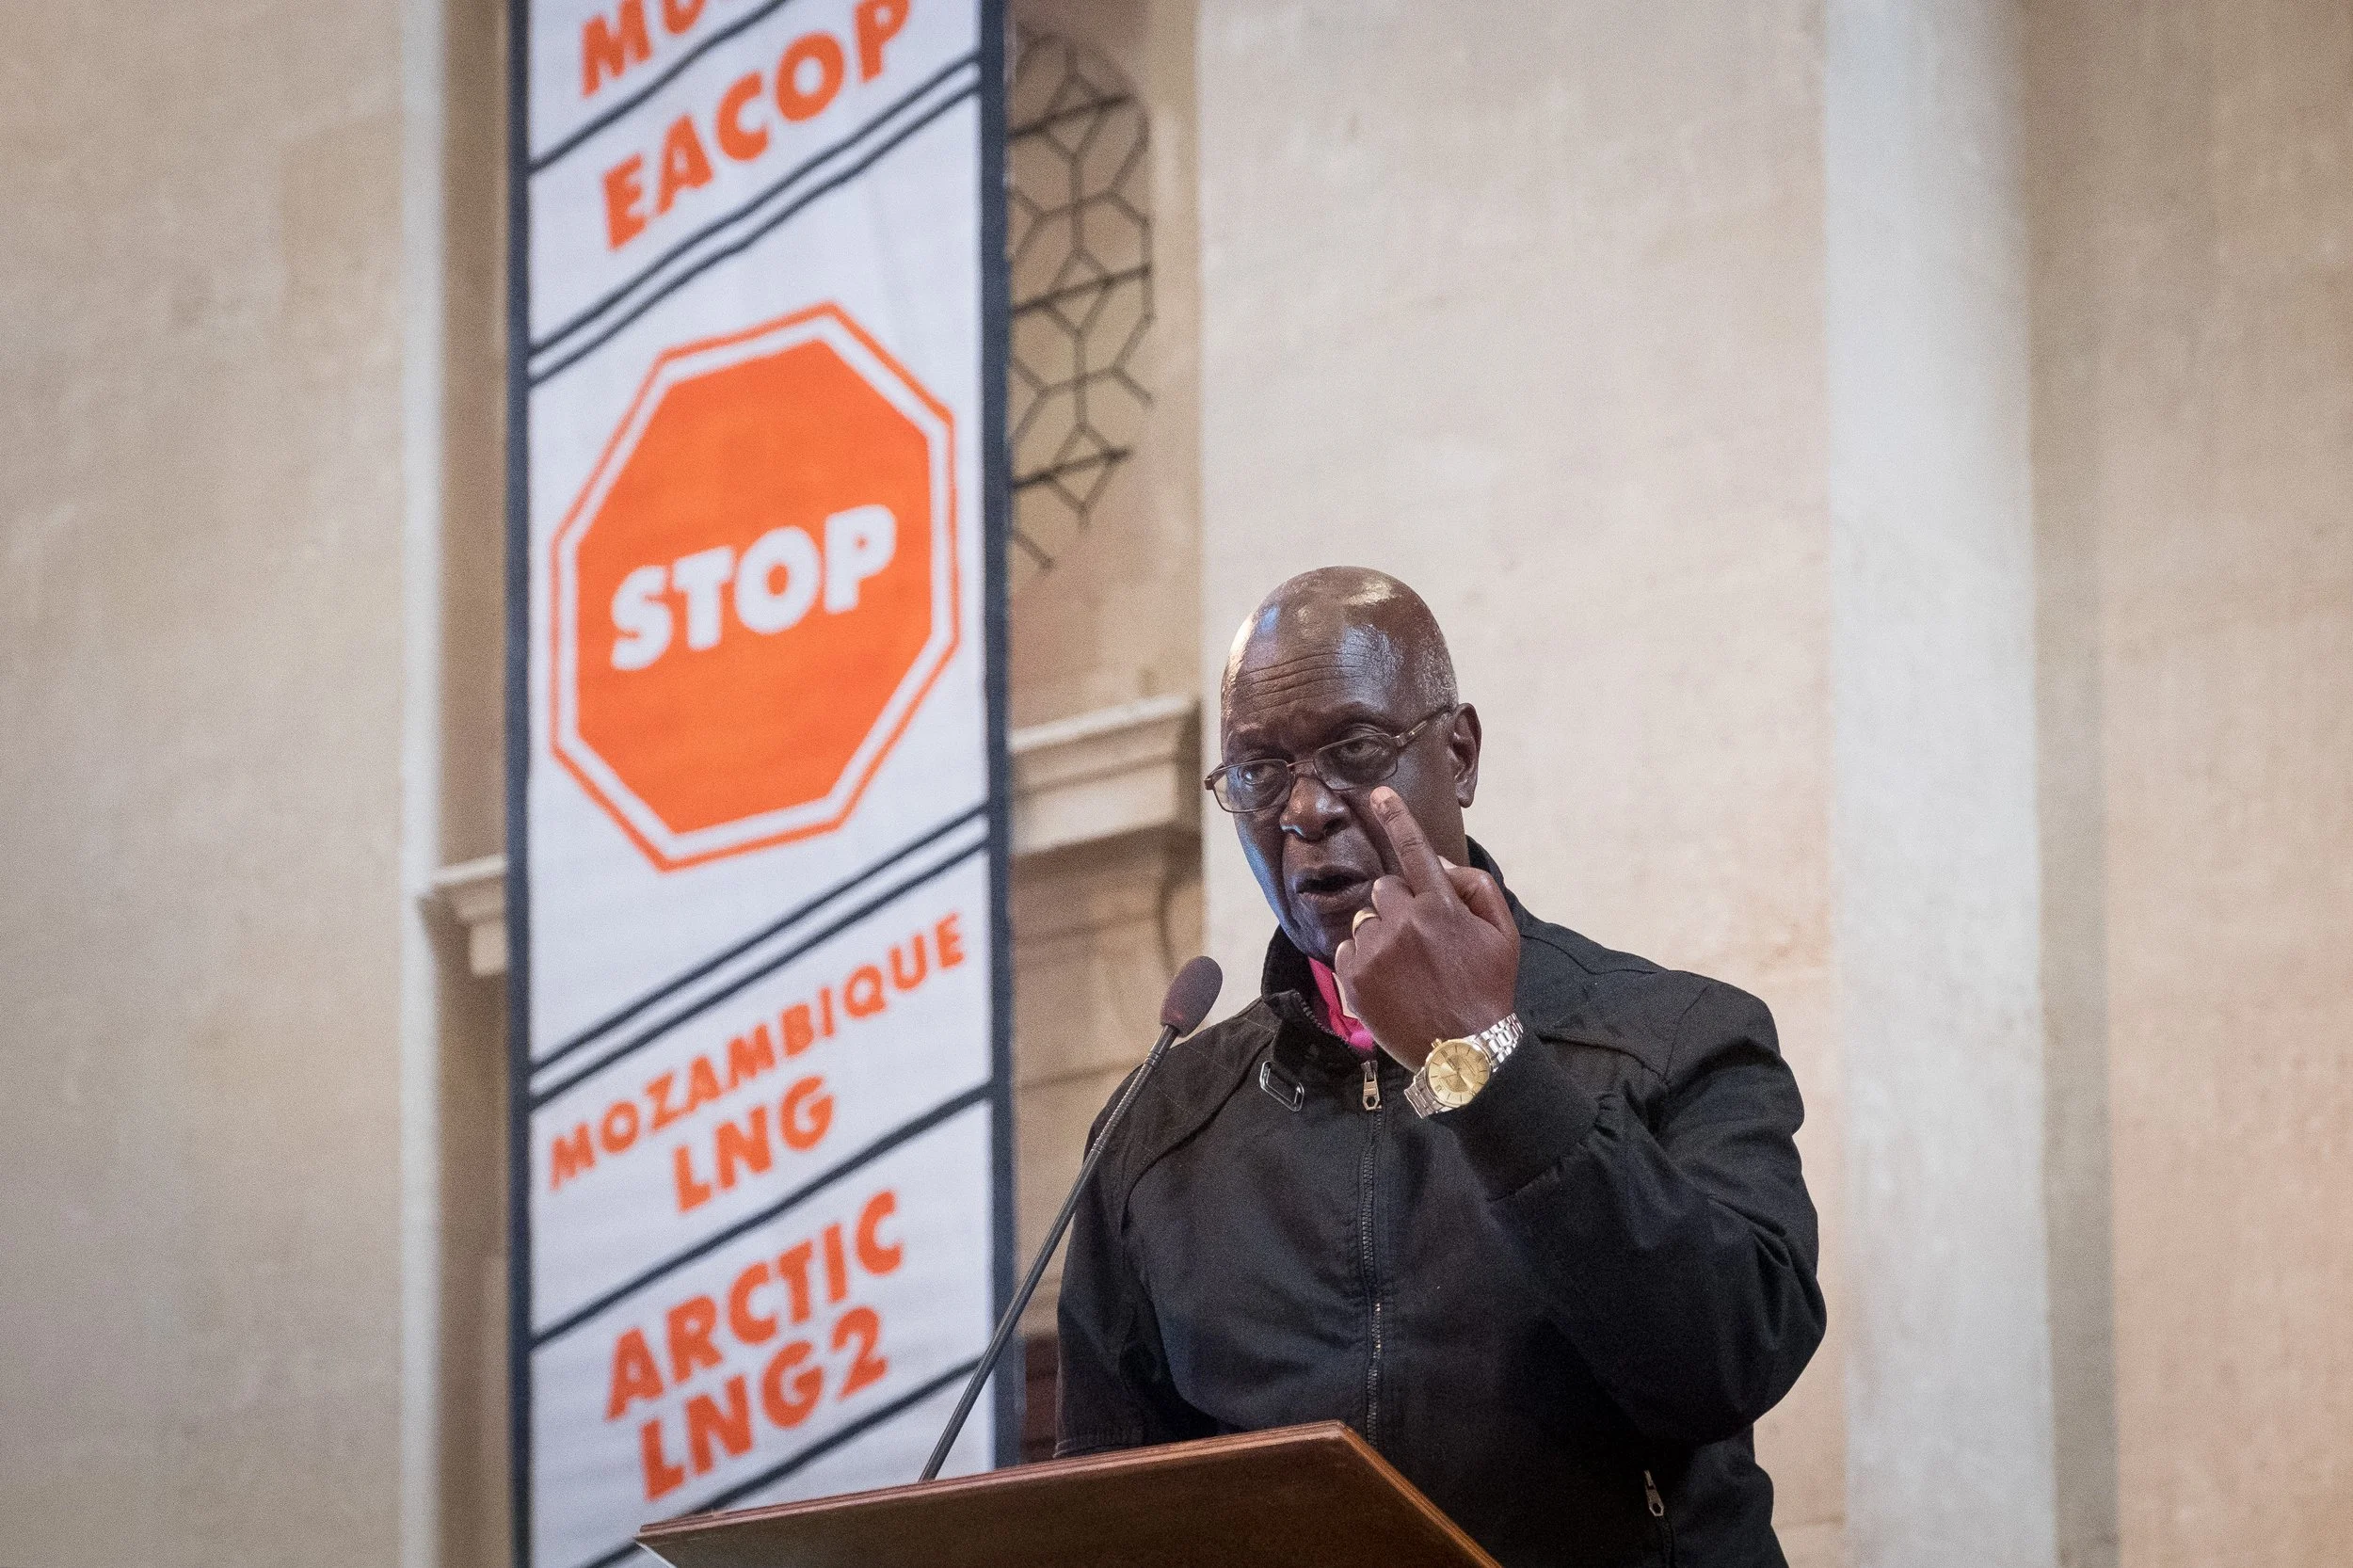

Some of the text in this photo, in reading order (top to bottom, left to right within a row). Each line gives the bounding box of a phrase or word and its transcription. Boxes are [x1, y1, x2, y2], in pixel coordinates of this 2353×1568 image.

[603, 0, 911, 249] EACOP
[610, 503, 897, 671] STOP
[552, 915, 964, 1190] MOZAMBIQUE
[675, 1076, 833, 1212] LNG
[607, 1191, 903, 1420] ARCTIC
[641, 1306, 888, 1501] LNG2
